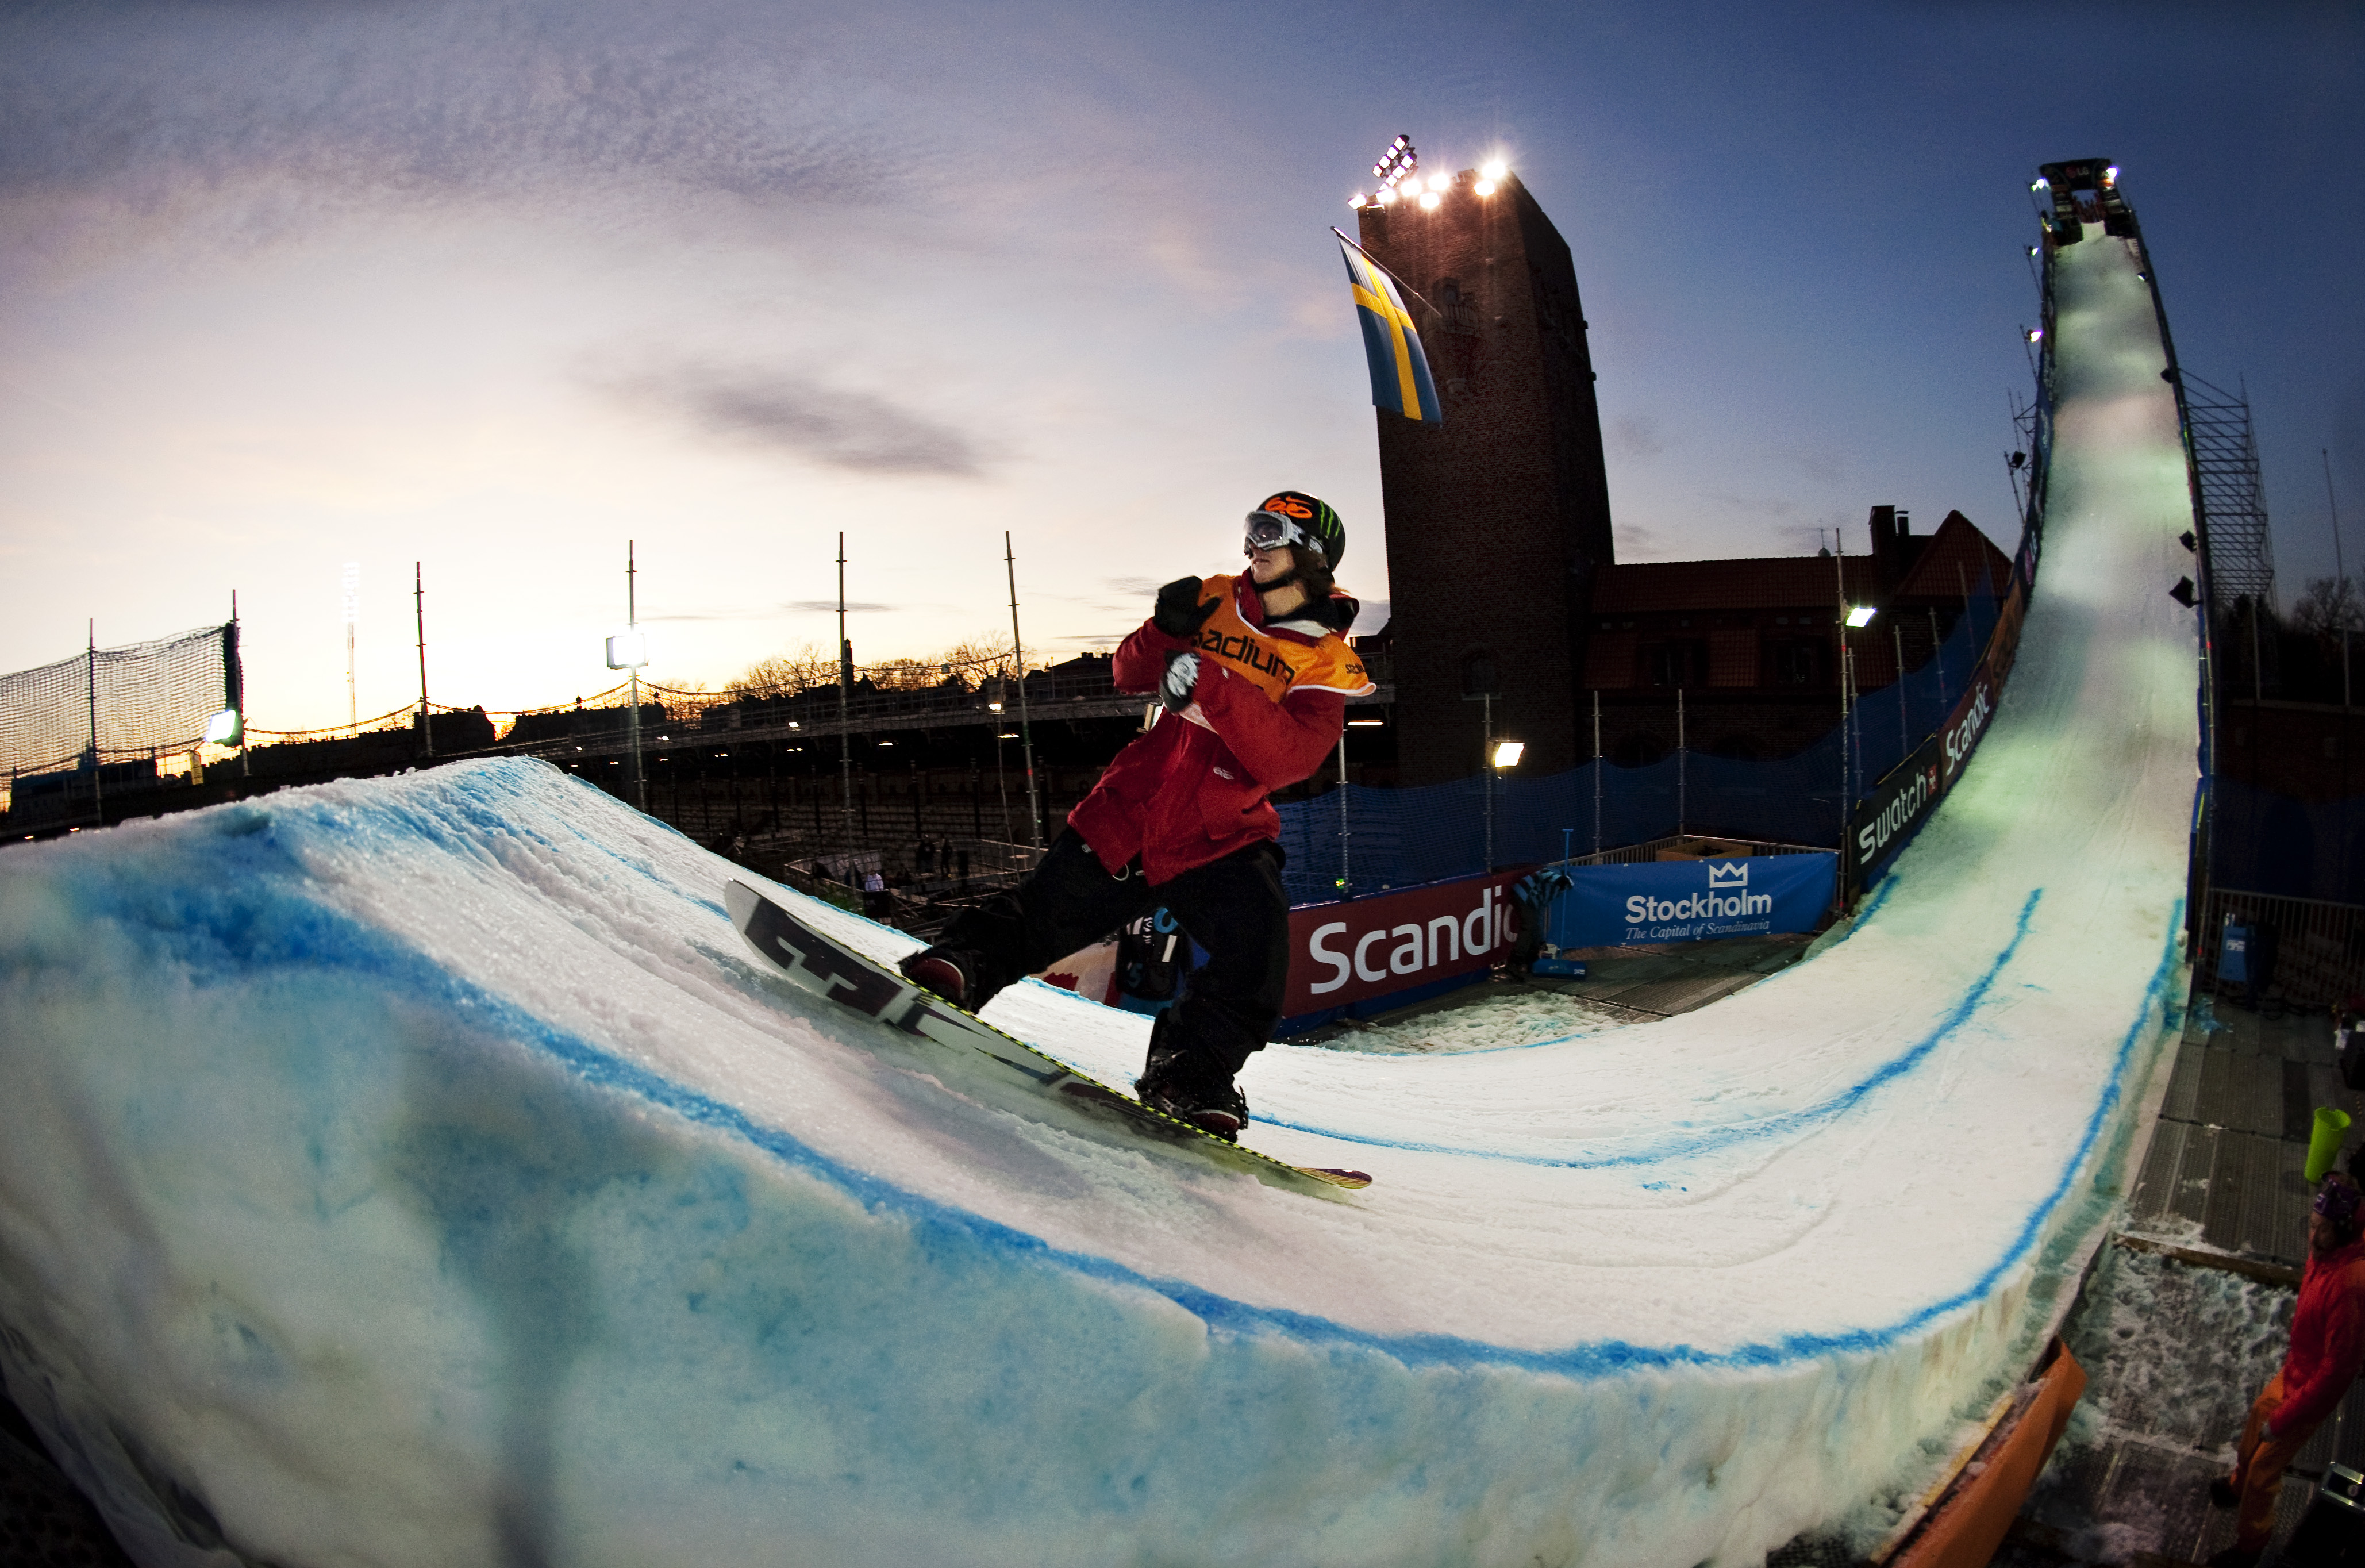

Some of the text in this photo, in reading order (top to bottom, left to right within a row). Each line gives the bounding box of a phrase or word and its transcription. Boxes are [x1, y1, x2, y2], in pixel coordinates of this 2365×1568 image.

[1946, 682, 1990, 775] Scandic
[1625, 889, 1772, 923] Stockholm
[1626, 918, 1770, 940] The Capital of Scandinavia
